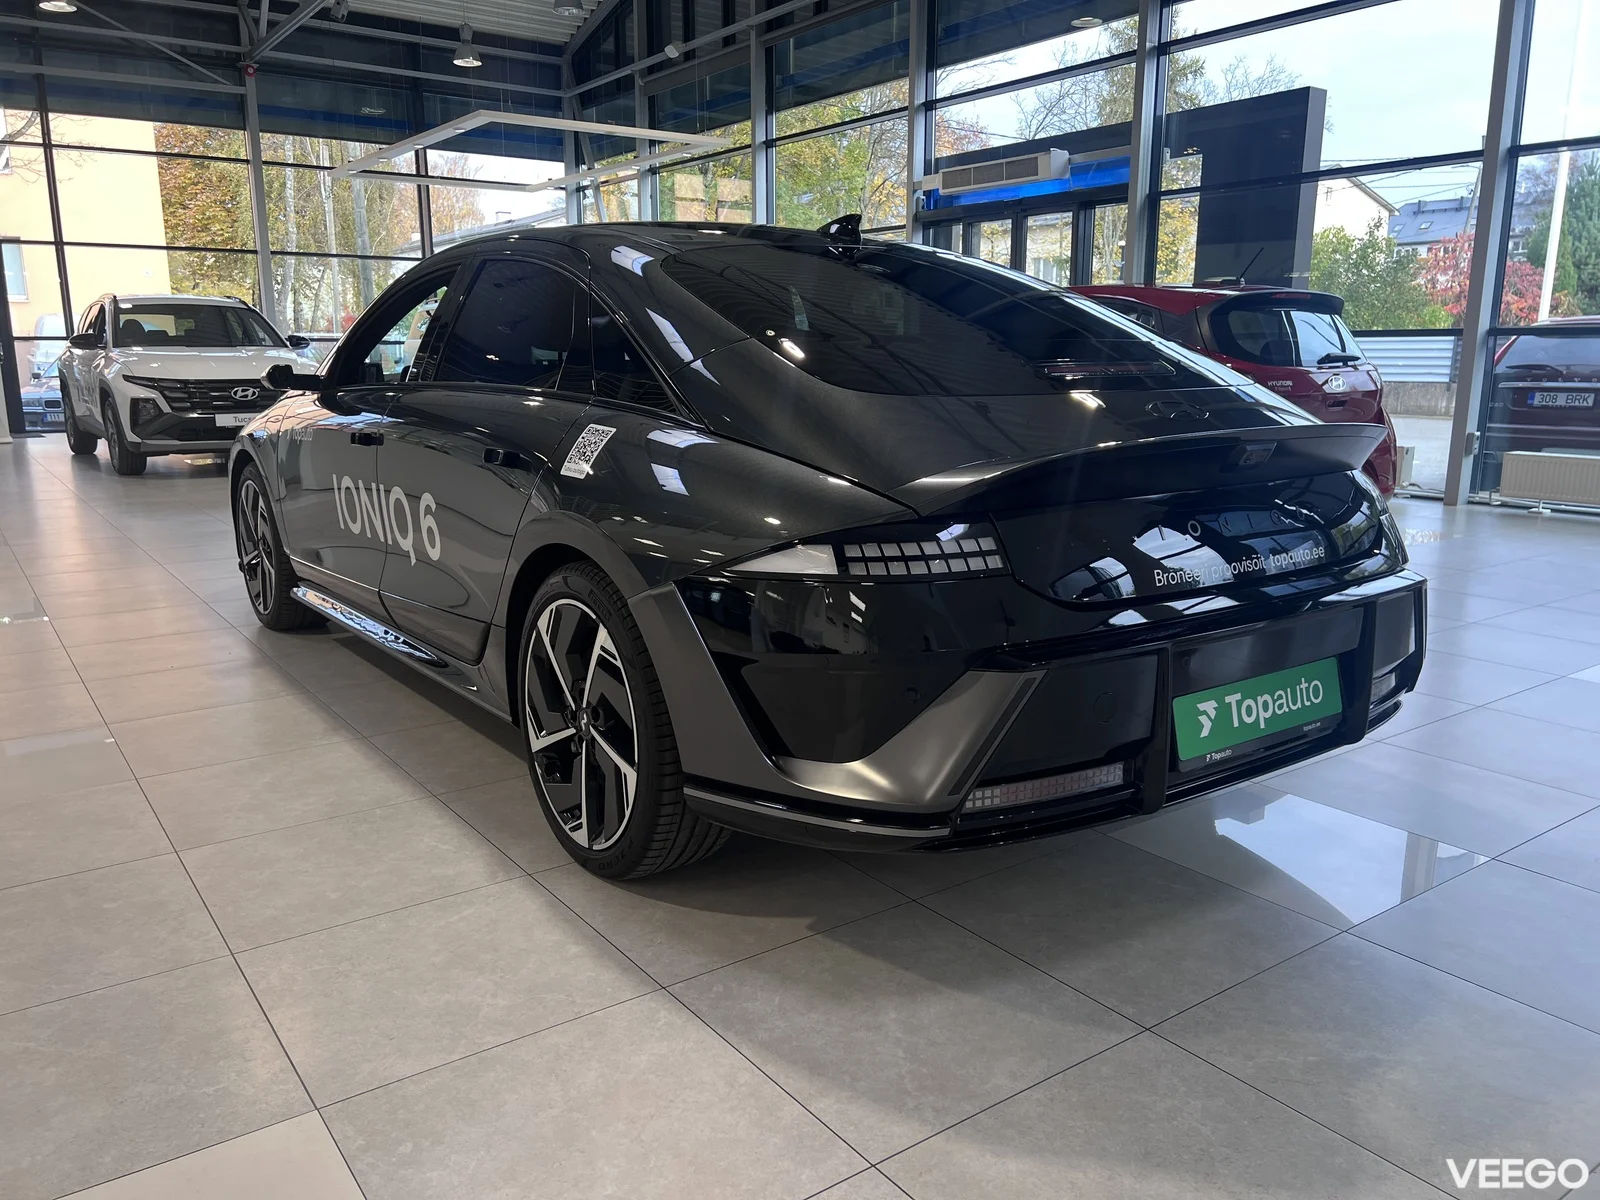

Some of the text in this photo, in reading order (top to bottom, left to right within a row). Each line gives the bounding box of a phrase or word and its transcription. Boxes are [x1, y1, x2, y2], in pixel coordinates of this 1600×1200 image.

[1538, 393, 1592, 405] 308 BRK
[332, 473, 441, 567] IONIQ 6
[1153, 545, 1325, 587] Broneeri proovisõit topauto.ee
[1224, 677, 1324, 729] Topauto
[1211, 748, 1233, 761] Topauto
